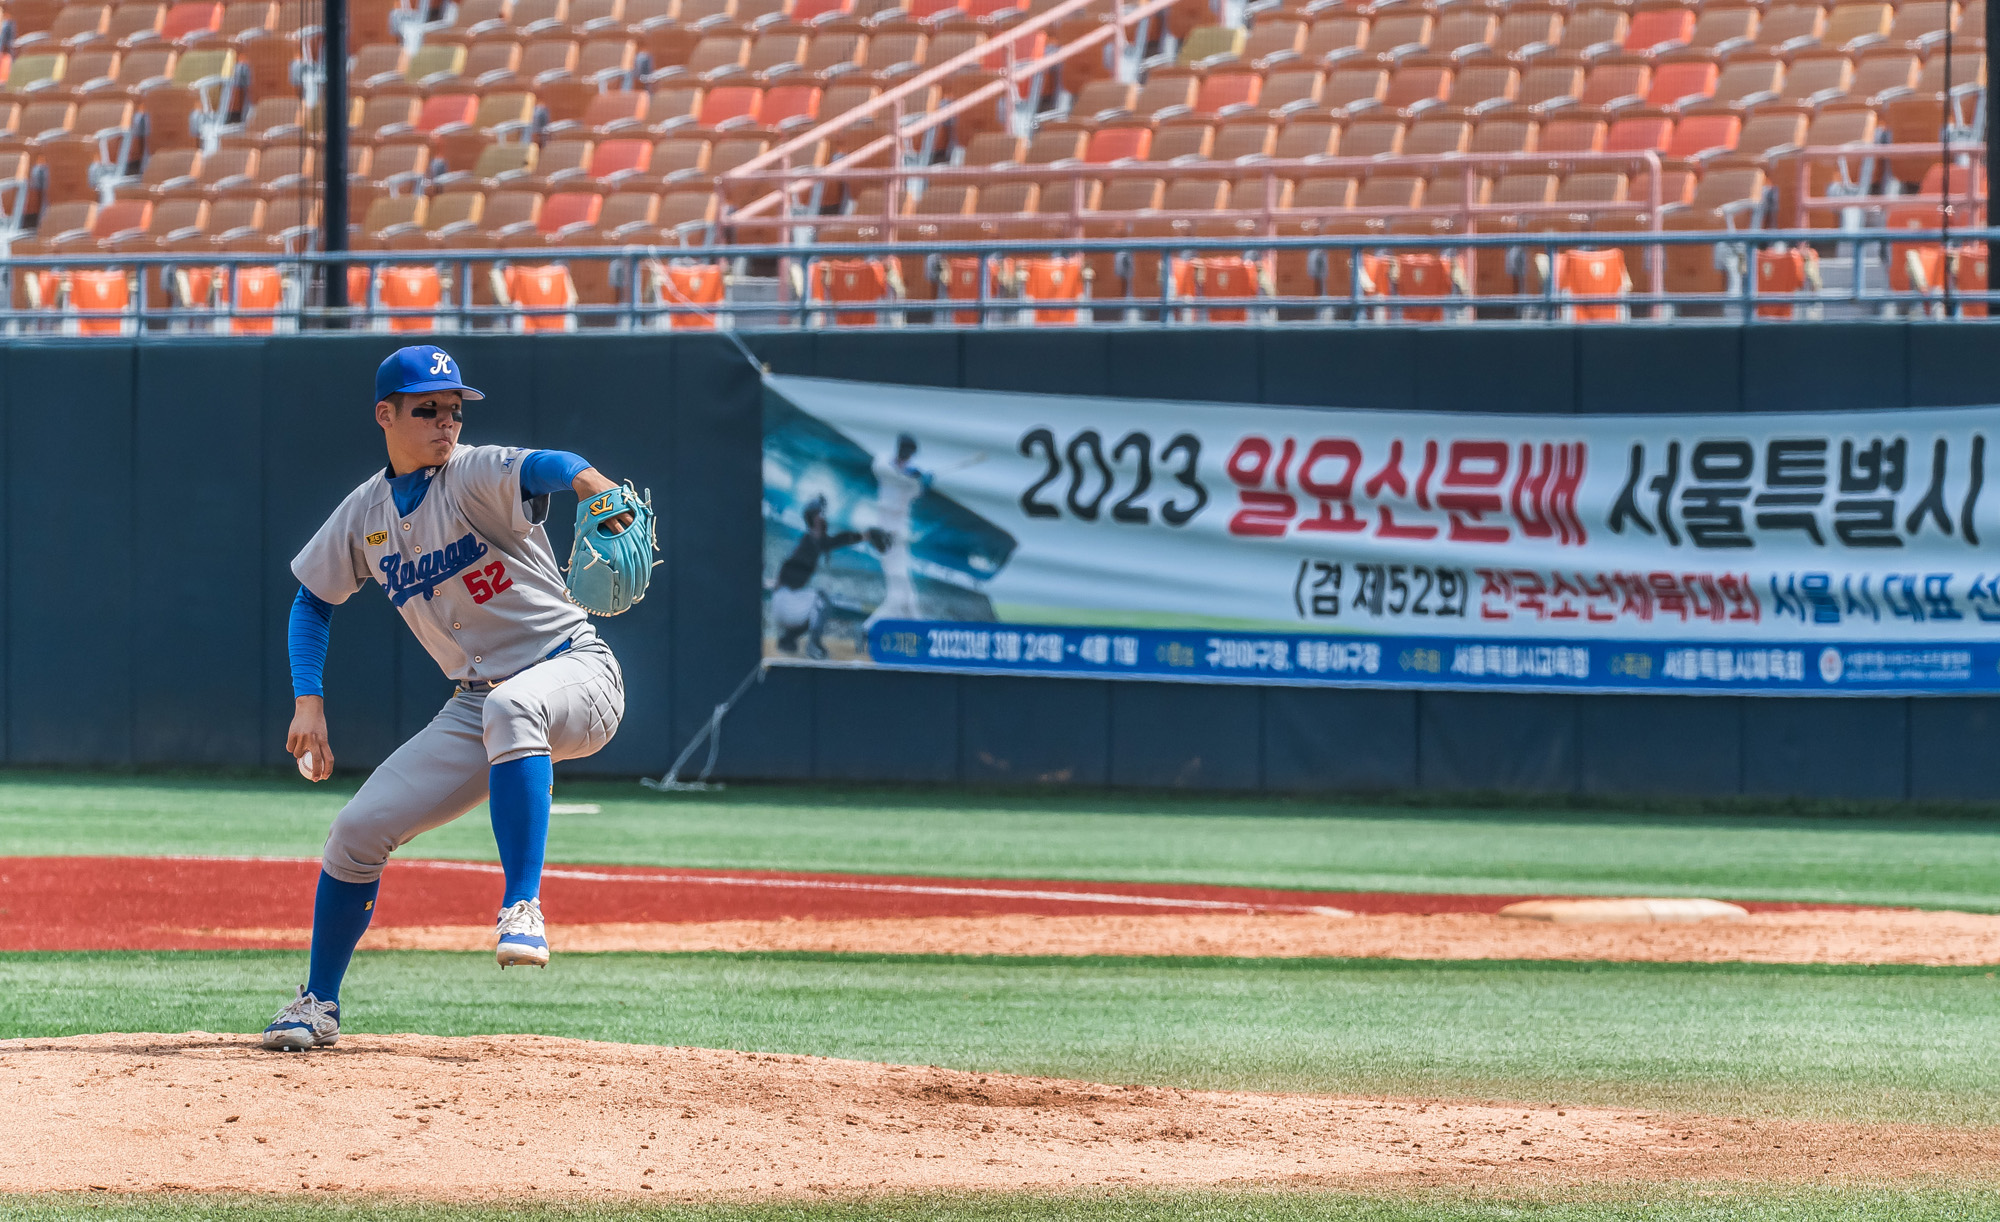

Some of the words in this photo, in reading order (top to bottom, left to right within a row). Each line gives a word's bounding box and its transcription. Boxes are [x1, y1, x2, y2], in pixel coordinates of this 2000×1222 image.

[430, 352, 452, 375] K
[1019, 427, 1208, 526] 2023
[1226, 437, 1587, 546] 일요신문배
[1607, 435, 1985, 548] 서울특별시
[462, 560, 514, 604] 52
[1294, 560, 1341, 619] (겸
[1352, 562, 1468, 618] 제52회)
[1475, 568, 1761, 624] 전국소년체육대회
